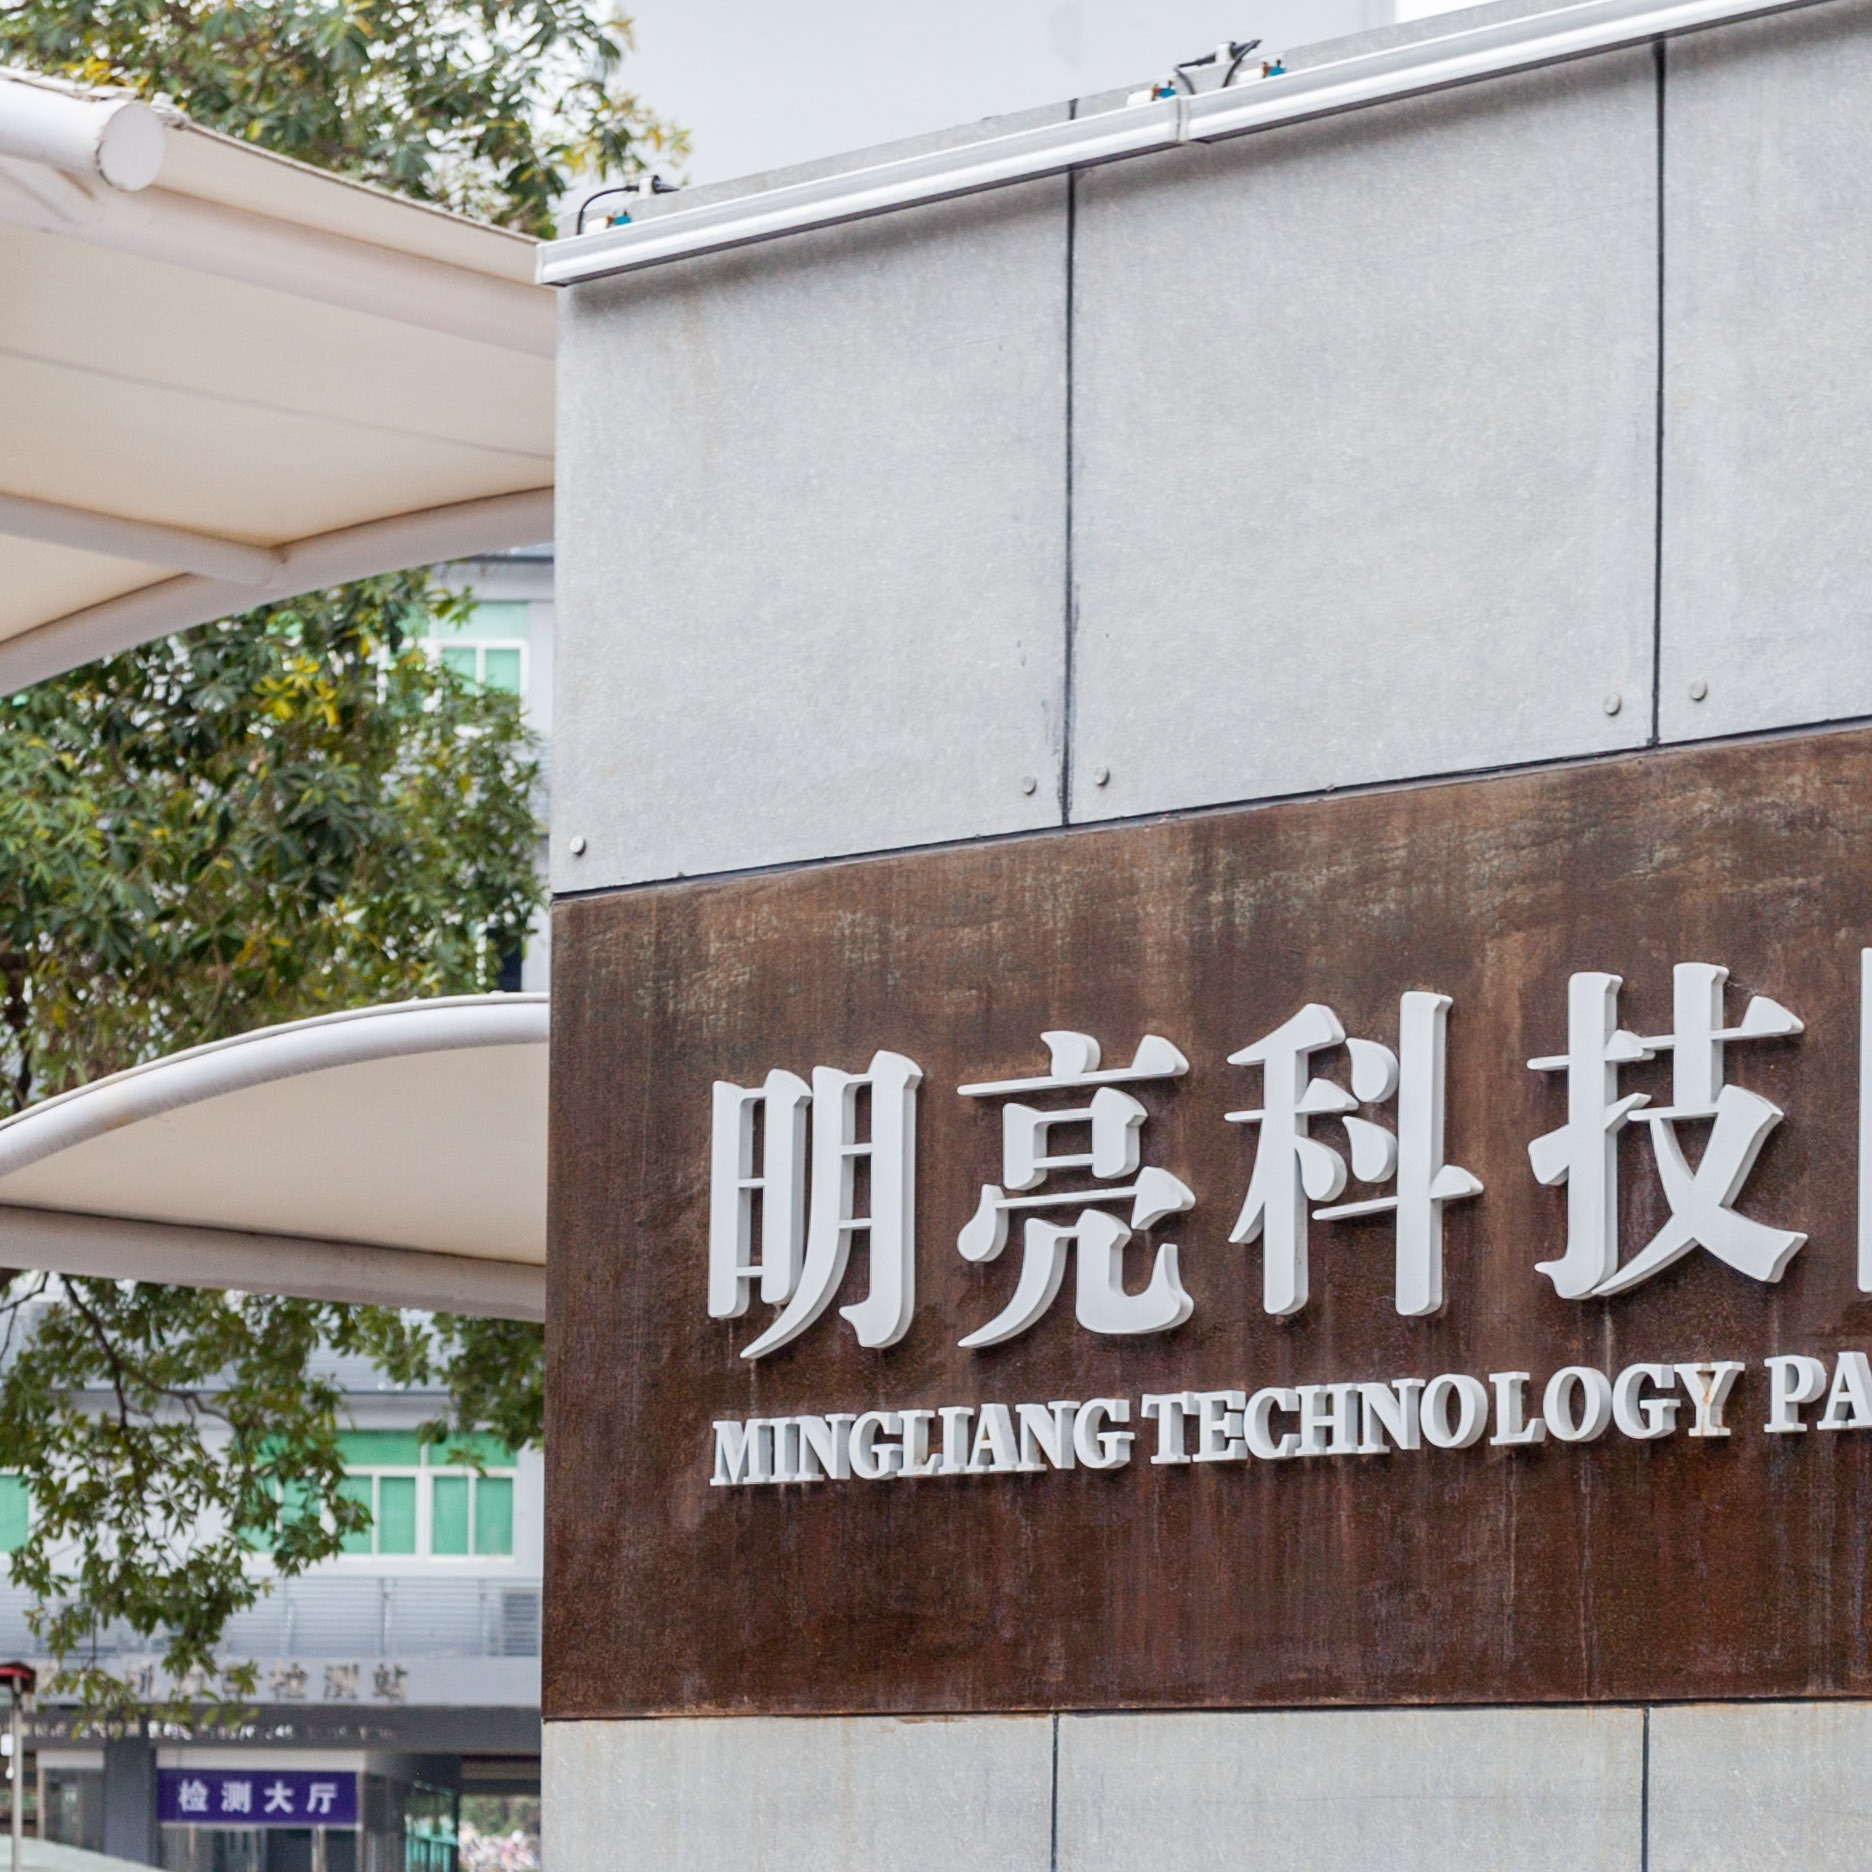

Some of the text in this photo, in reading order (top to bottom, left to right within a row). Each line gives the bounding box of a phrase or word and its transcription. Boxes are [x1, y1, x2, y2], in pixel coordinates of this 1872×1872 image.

[710, 1397, 1133, 1486] MINGLIANG
[1141, 1360, 1745, 1465] TECHNOLOGY
[179, 1779, 338, 1814] 检测大厅
